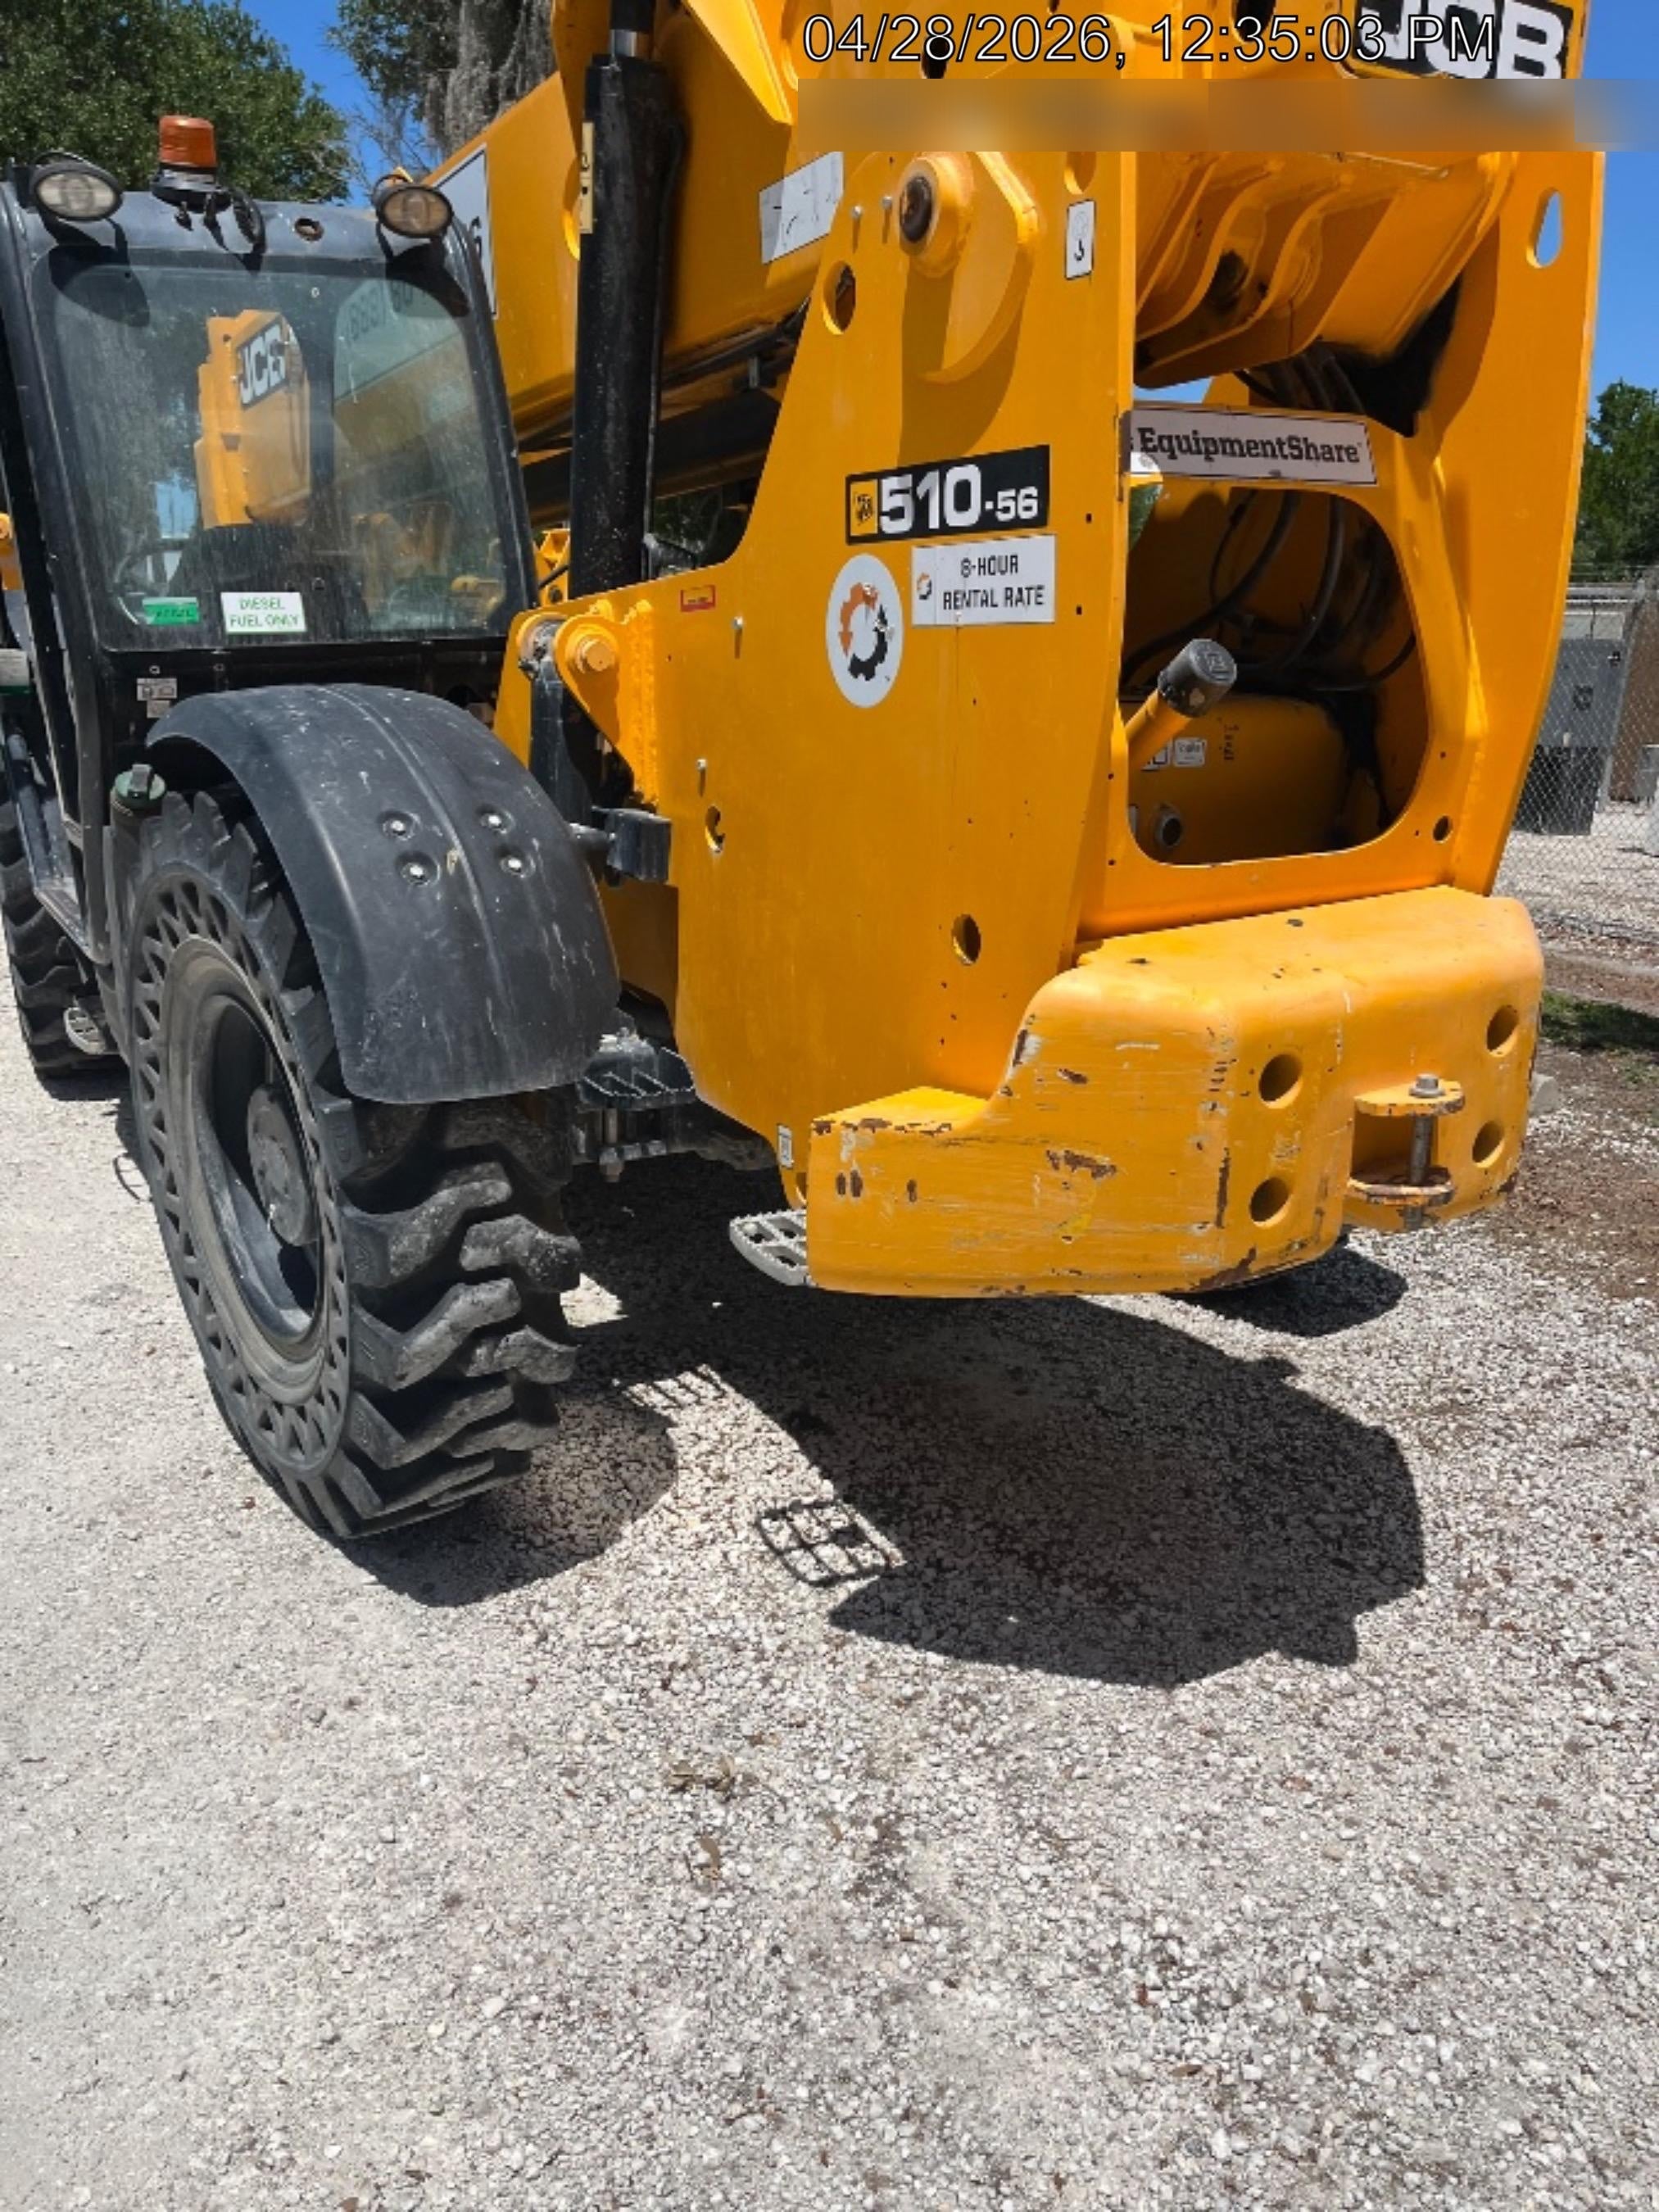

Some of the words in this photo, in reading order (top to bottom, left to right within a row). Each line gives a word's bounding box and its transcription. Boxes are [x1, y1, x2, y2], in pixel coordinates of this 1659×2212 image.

[1358, 0, 1566, 79] JCB
[1136, 427, 1362, 464] EquipmentShare
[879, 464, 1039, 534] 510-56
[960, 554, 1019, 578] 8-HOUR
[238, 596, 285, 610] DIESEL
[943, 588, 999, 610] RENTAL
[1004, 584, 1045, 608] RATE
[230, 614, 263, 628] FUEL
[265, 614, 298, 627] ONLY
